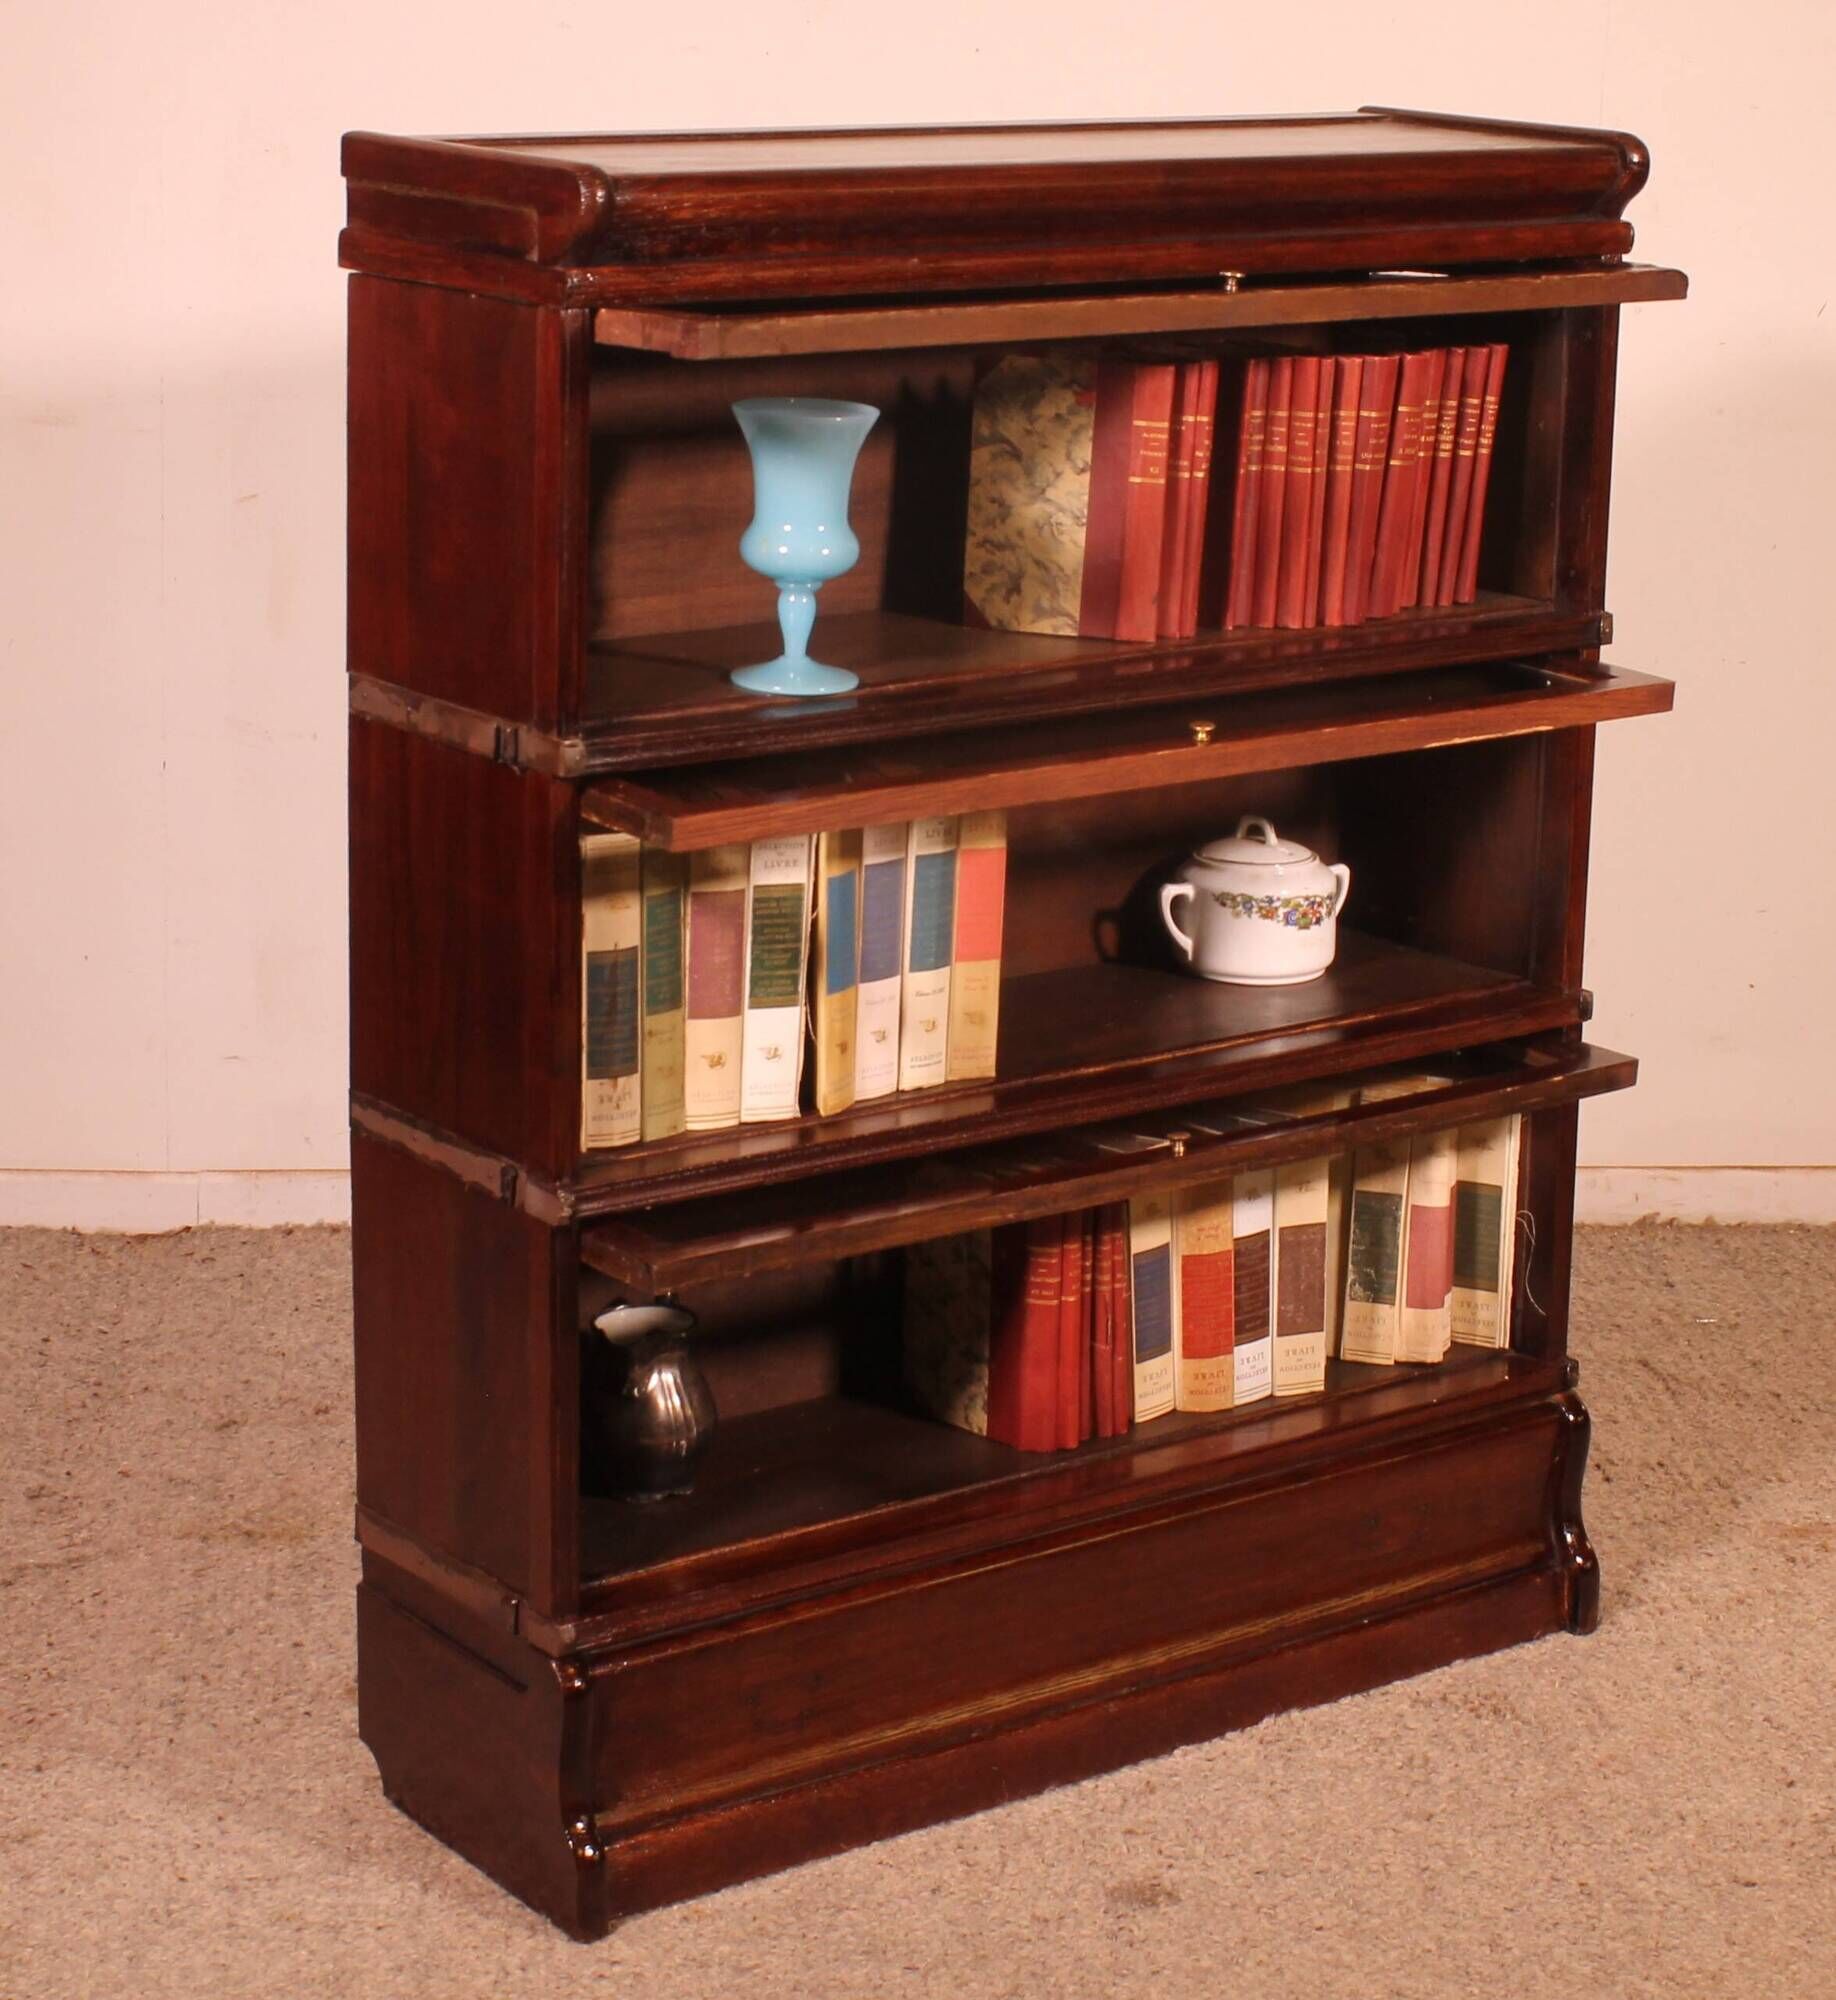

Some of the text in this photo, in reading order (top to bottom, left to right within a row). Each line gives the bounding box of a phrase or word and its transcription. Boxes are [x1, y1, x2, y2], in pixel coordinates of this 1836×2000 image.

[763, 859, 800, 870] LIVRE
[1284, 1345, 1315, 1357] LIVRE
[1240, 1352, 1265, 1366] LIVRE
[1193, 1369, 1225, 1380] LIVRE
